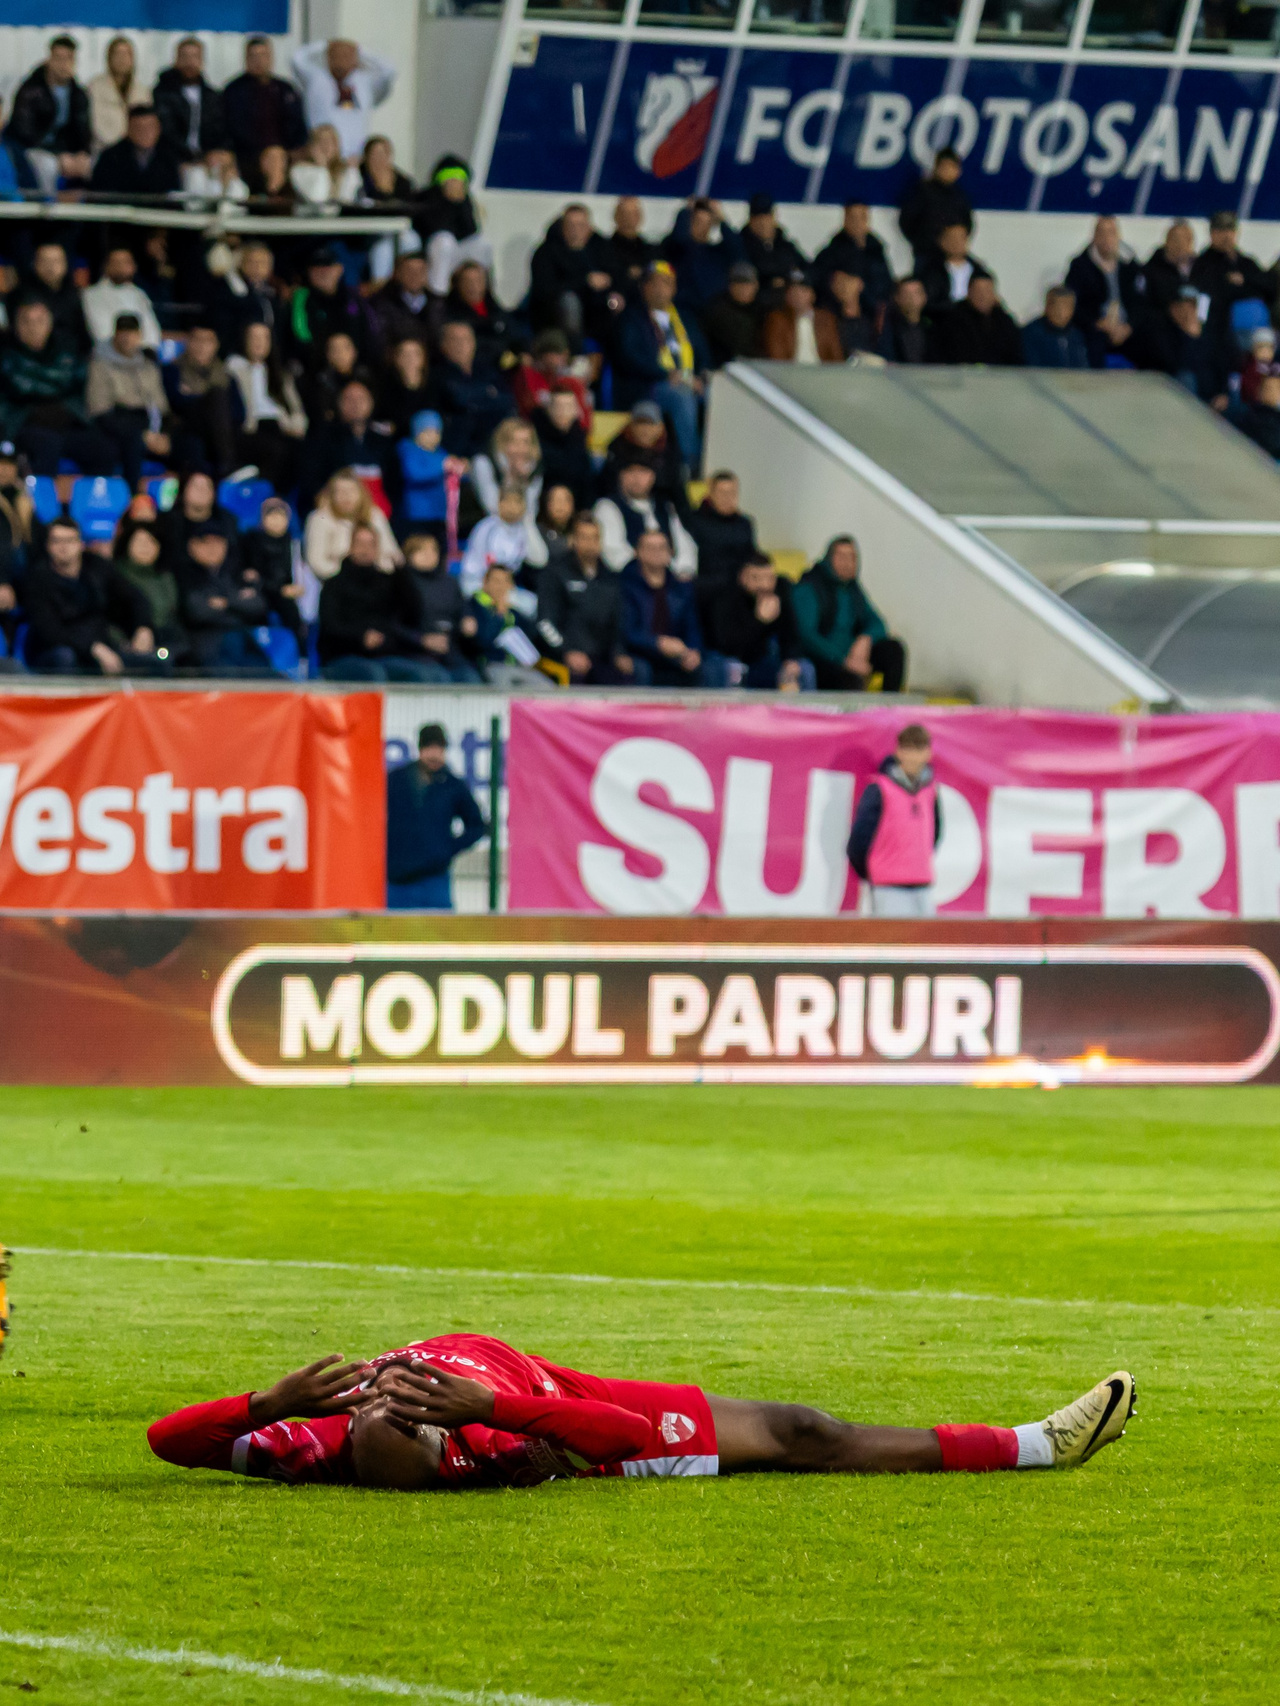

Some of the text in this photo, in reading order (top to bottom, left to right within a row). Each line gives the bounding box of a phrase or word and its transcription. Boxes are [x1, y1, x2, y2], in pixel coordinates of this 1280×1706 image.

[734, 86, 842, 167] FC
[279, 971, 1022, 1059] MODUL PARIURI
